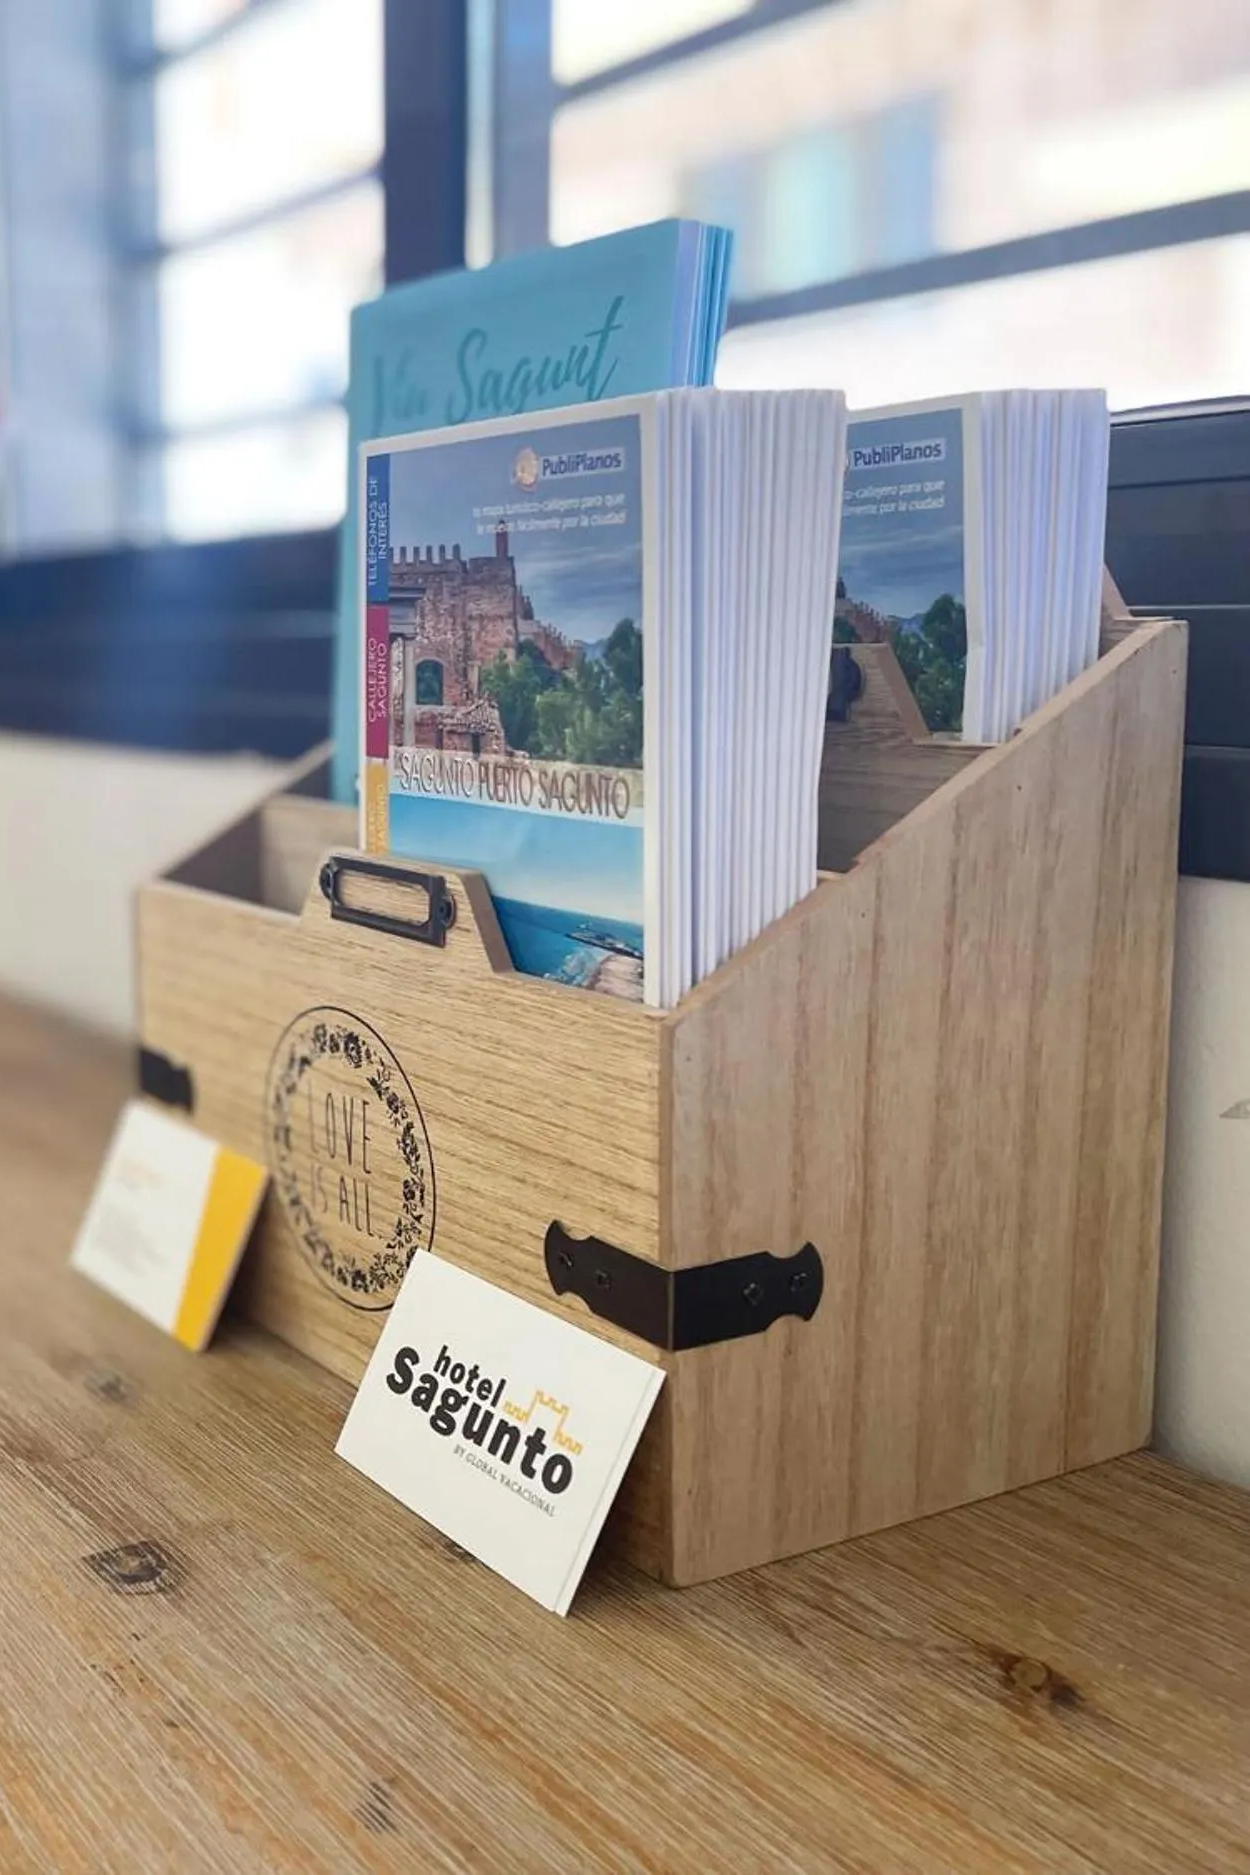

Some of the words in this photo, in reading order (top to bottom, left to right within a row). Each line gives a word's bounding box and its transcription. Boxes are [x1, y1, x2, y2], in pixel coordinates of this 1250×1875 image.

[445, 295, 626, 425] Sagunt
[542, 451, 623, 478] PubliPlanos
[853, 443, 942, 467] PubliPlanos
[367, 636, 378, 724] CALLEJERO
[376, 642, 388, 720] SAGUNTO
[398, 753, 474, 798] SAGUNTO
[477, 760, 534, 807] PUERTO
[538, 770, 631, 820] SAGUNTO
[305, 1079, 373, 1175] LOVE
[432, 1344, 508, 1409] hotel
[385, 1345, 574, 1496] Sagunto
[452, 1442, 467, 1457] BY
[465, 1450, 498, 1481] GLOBAL
[498, 1472, 556, 1517] VACACIONAL
